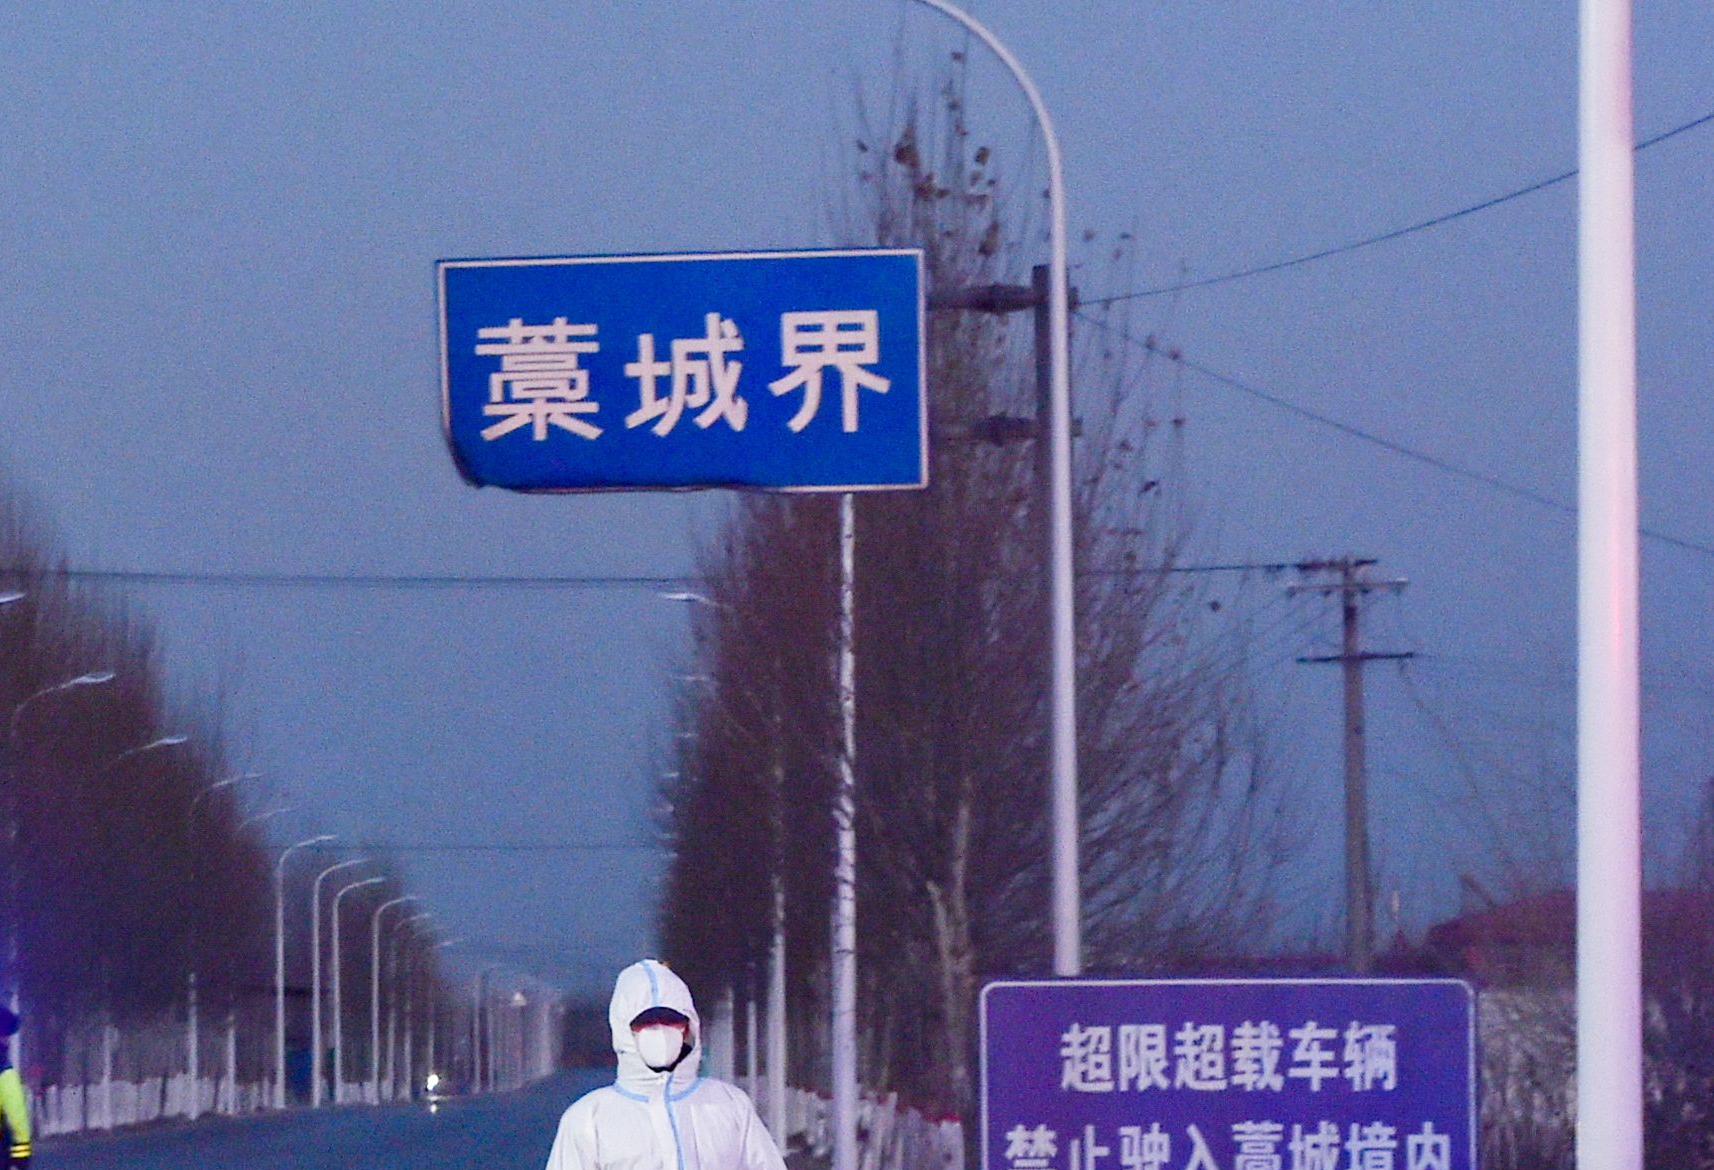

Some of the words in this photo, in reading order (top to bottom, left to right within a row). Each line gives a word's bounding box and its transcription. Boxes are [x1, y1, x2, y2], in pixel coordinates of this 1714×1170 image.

[476, 309, 891, 441] 藁城界
[1060, 1020, 1398, 1093] 超限超载车辆
